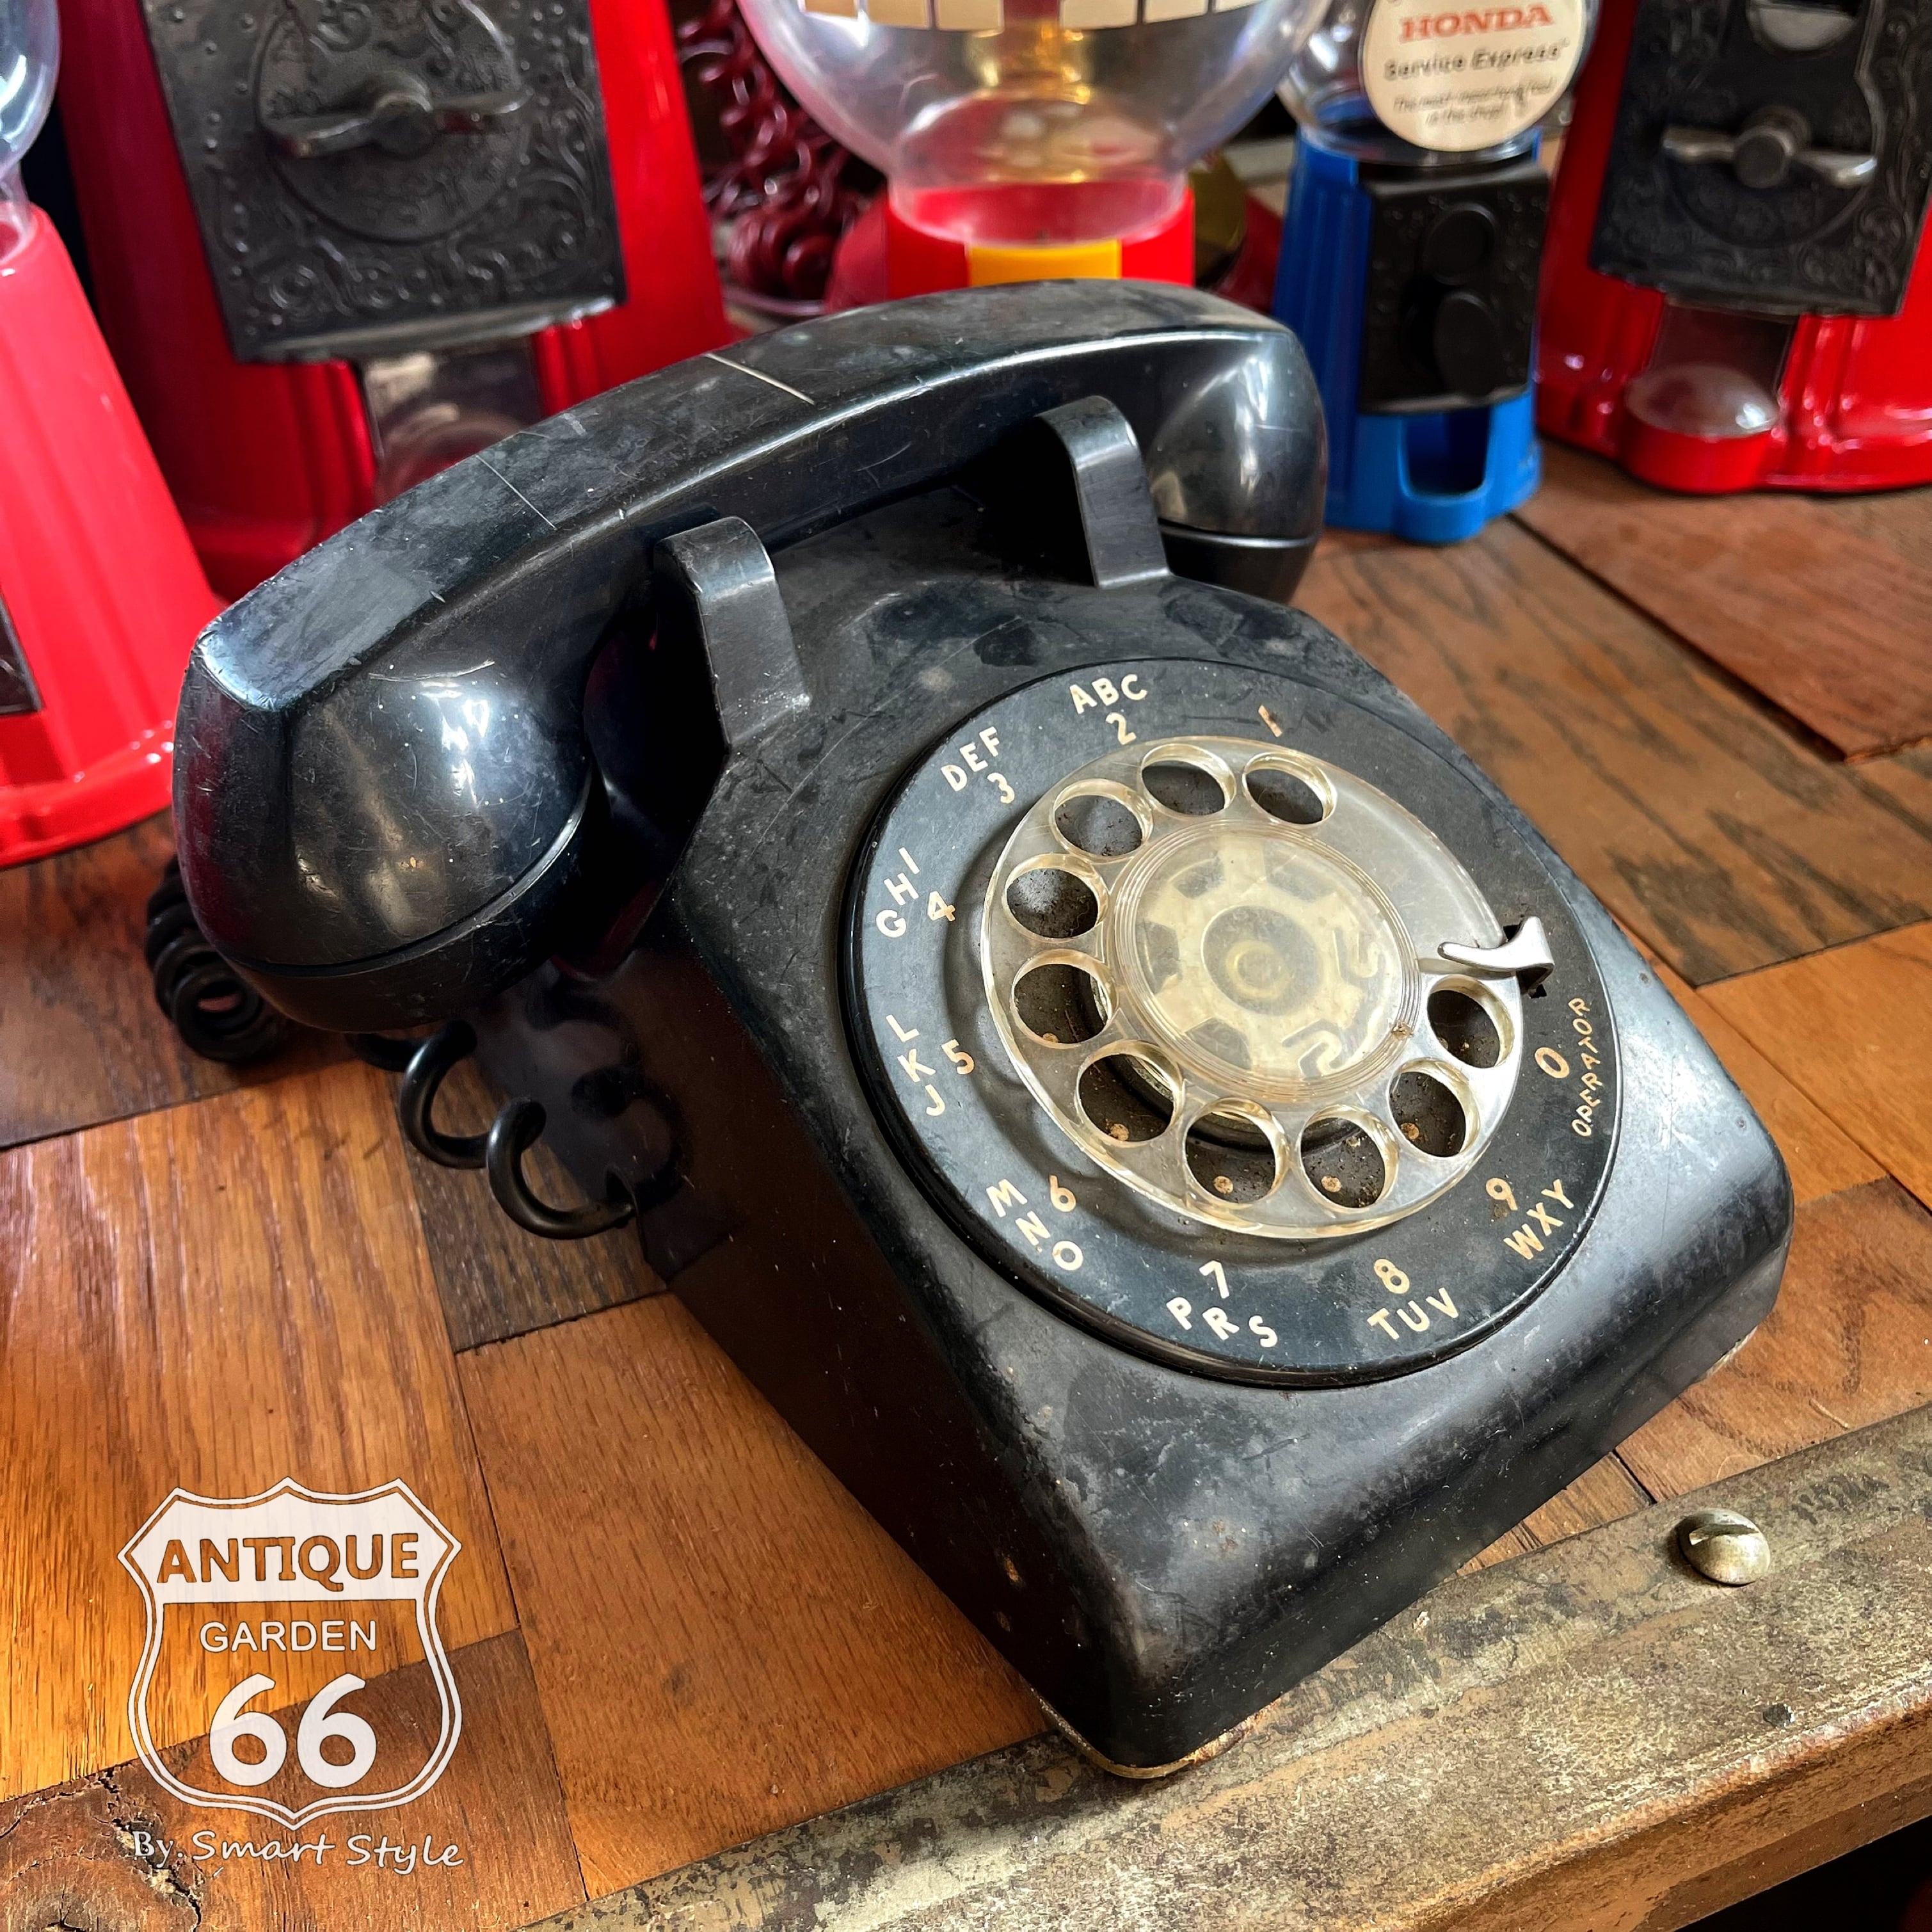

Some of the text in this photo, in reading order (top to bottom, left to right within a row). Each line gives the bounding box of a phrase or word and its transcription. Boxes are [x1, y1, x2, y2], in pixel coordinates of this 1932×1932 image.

[1400, 4, 1554, 43] HONDA
[1384, 53, 1467, 81] Service
[1069, 673, 1147, 714] ABC
[1105, 712, 1137, 745] 2
[940, 726, 1001, 792] DEF
[986, 772, 1016, 804] 3
[875, 847, 920, 938] GHI
[926, 890, 956, 922] 4
[941, 1039, 975, 1074] 5
[1568, 997, 1603, 1137] OPERATOR
[1049, 1175, 1077, 1213] 6
[1485, 1177, 1519, 1211] 9
[986, 1178, 1084, 1272] MNO
[1503, 1178, 1574, 1261] WXY
[1199, 1259, 1229, 1299] 7
[1373, 1257, 1410, 1295] 8
[1166, 1296, 1278, 1348] PRS
[1366, 1286, 1459, 1341] TUV
